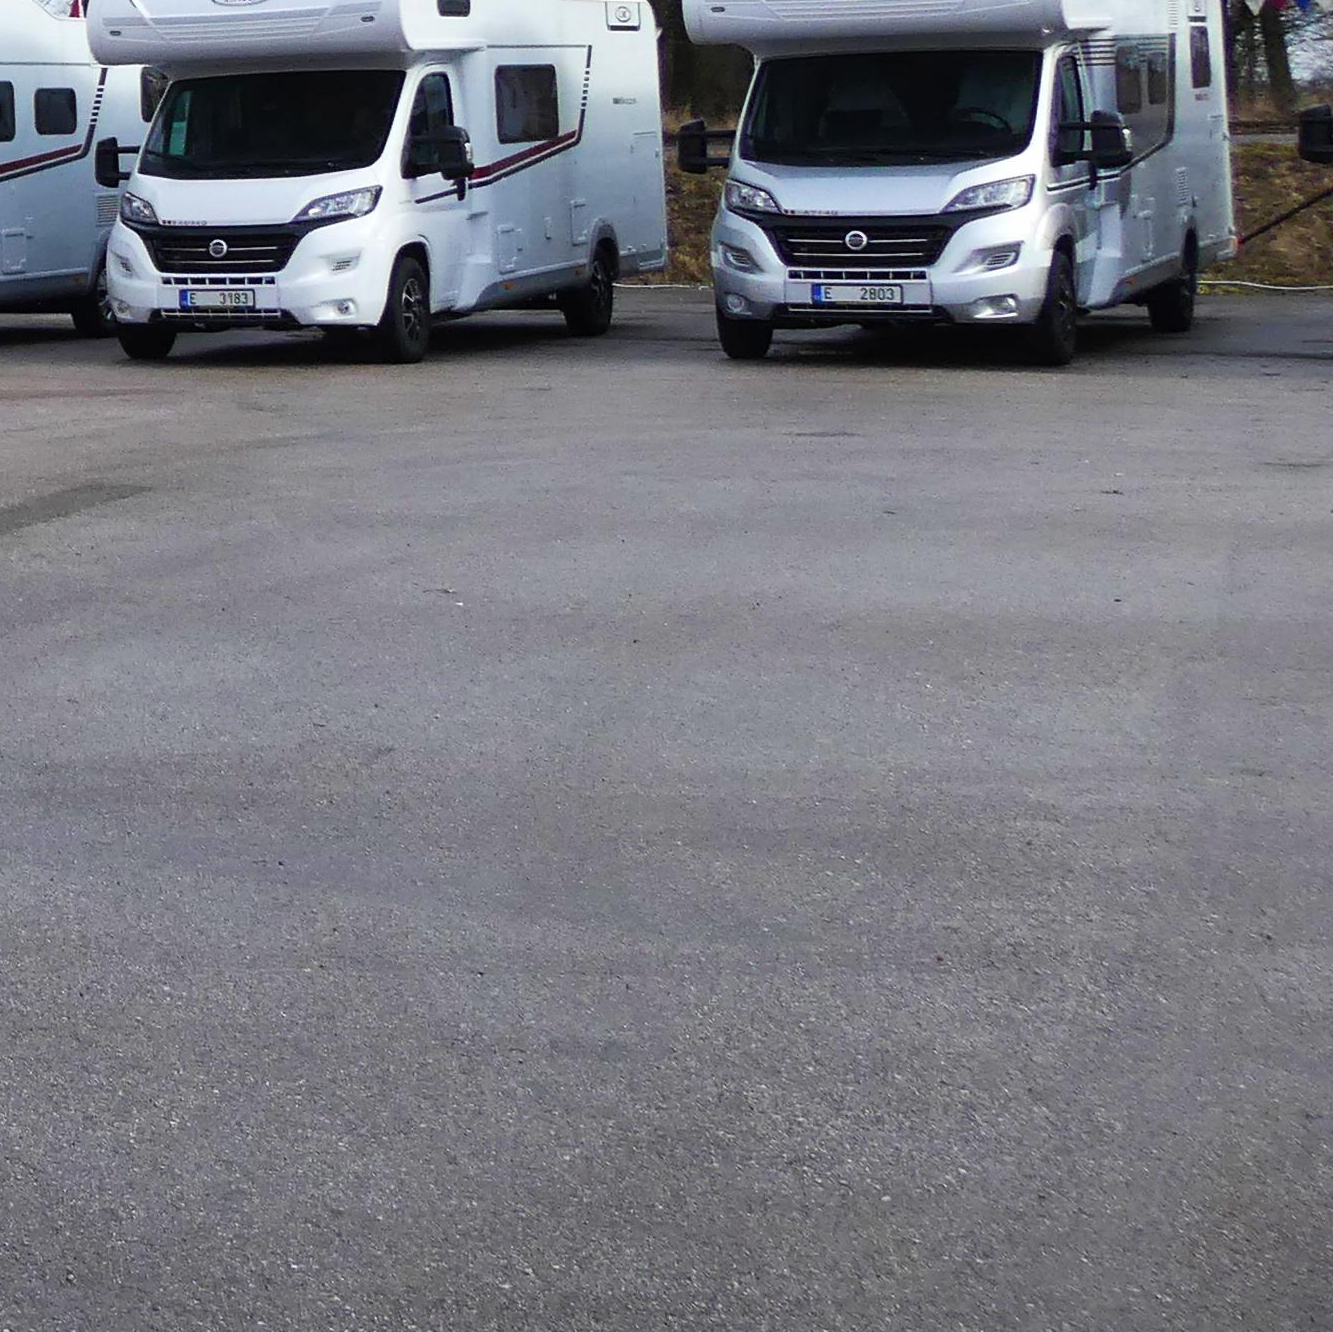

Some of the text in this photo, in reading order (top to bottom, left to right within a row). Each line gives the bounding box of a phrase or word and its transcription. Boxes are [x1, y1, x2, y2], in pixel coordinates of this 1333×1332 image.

[189, 292, 248, 305] E 3183
[824, 287, 895, 301] E 2803
